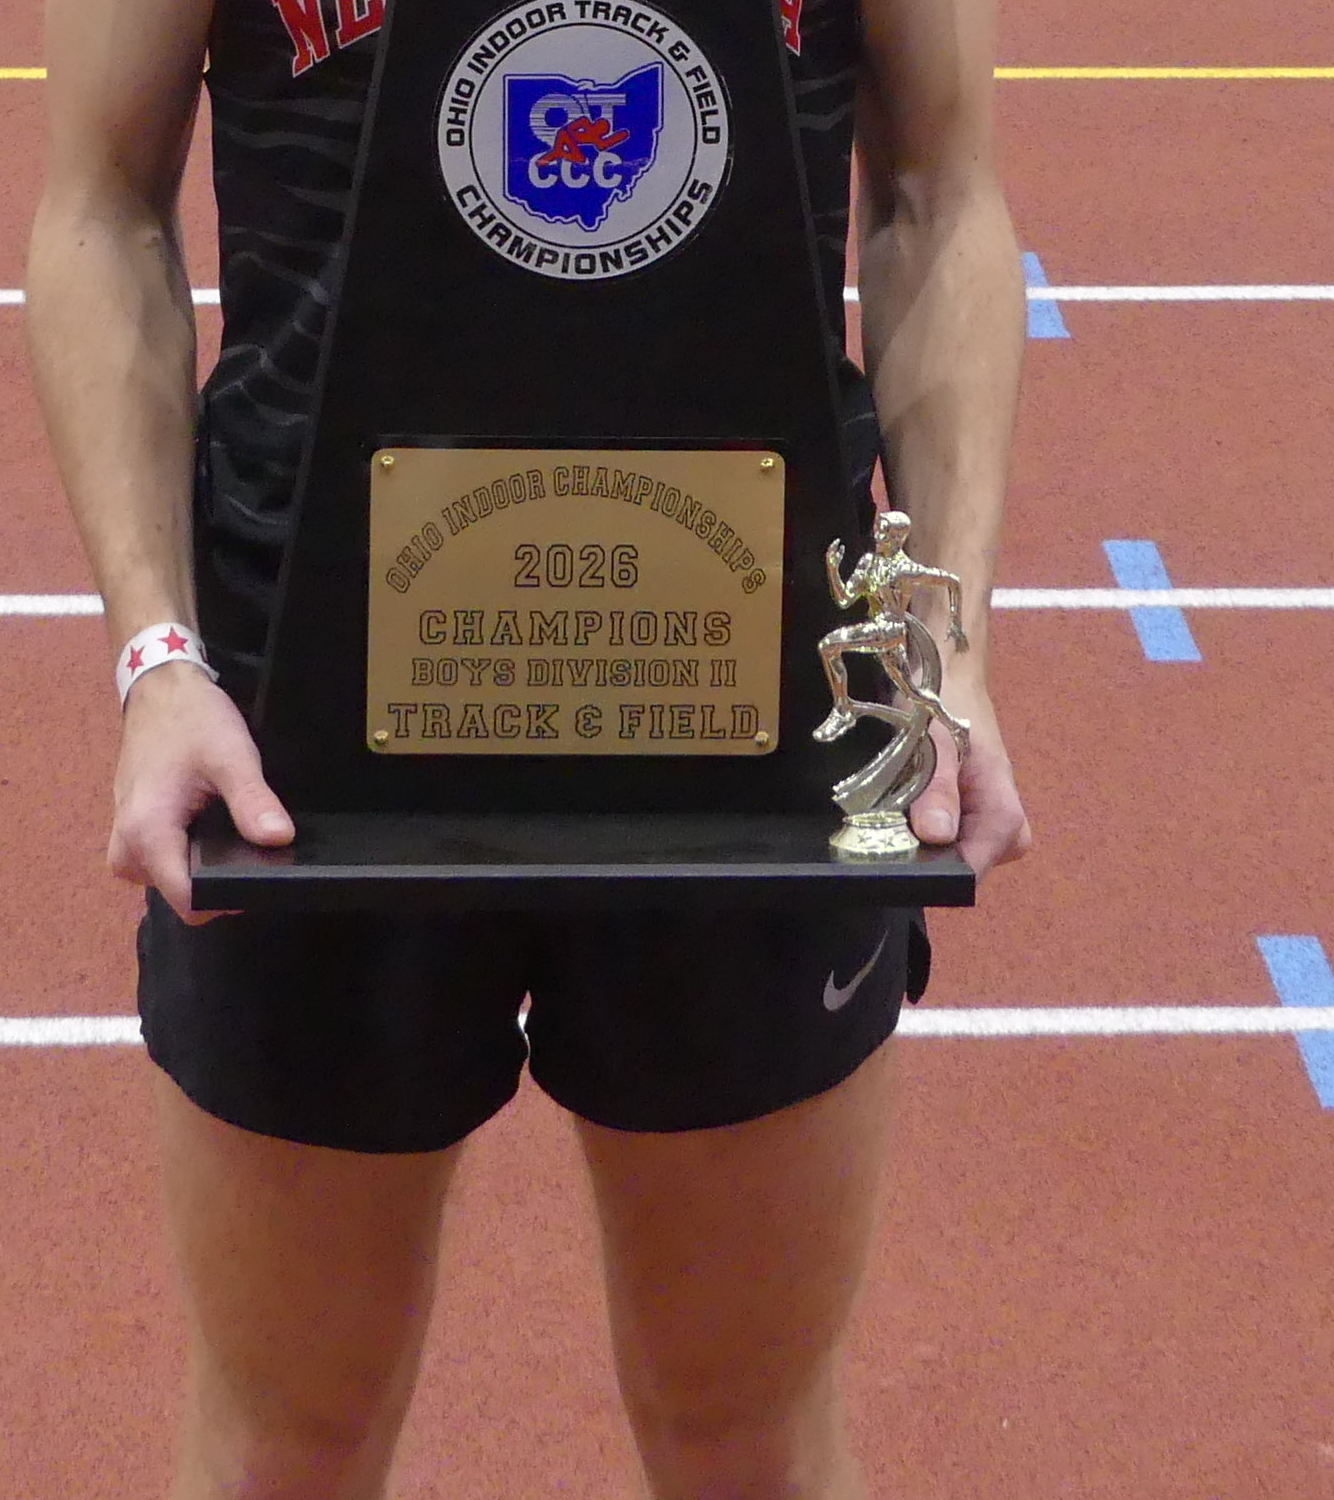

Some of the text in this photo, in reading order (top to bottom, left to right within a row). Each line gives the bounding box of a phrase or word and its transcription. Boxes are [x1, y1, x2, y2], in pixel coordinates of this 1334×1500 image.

[446, 0, 721, 147] OHIO INDOOR TRACK & FIELD
[456, 178, 714, 275] CHAMPIONSHIPS
[386, 465, 767, 594] OHIO INDOOR CHAMPIONSHIPS
[514, 544, 639, 588] 2026
[419, 610, 732, 646] CHAMPIONS
[411, 658, 737, 687] BOYS DIVISION II
[388, 703, 760, 740] TRACK & FIELD
